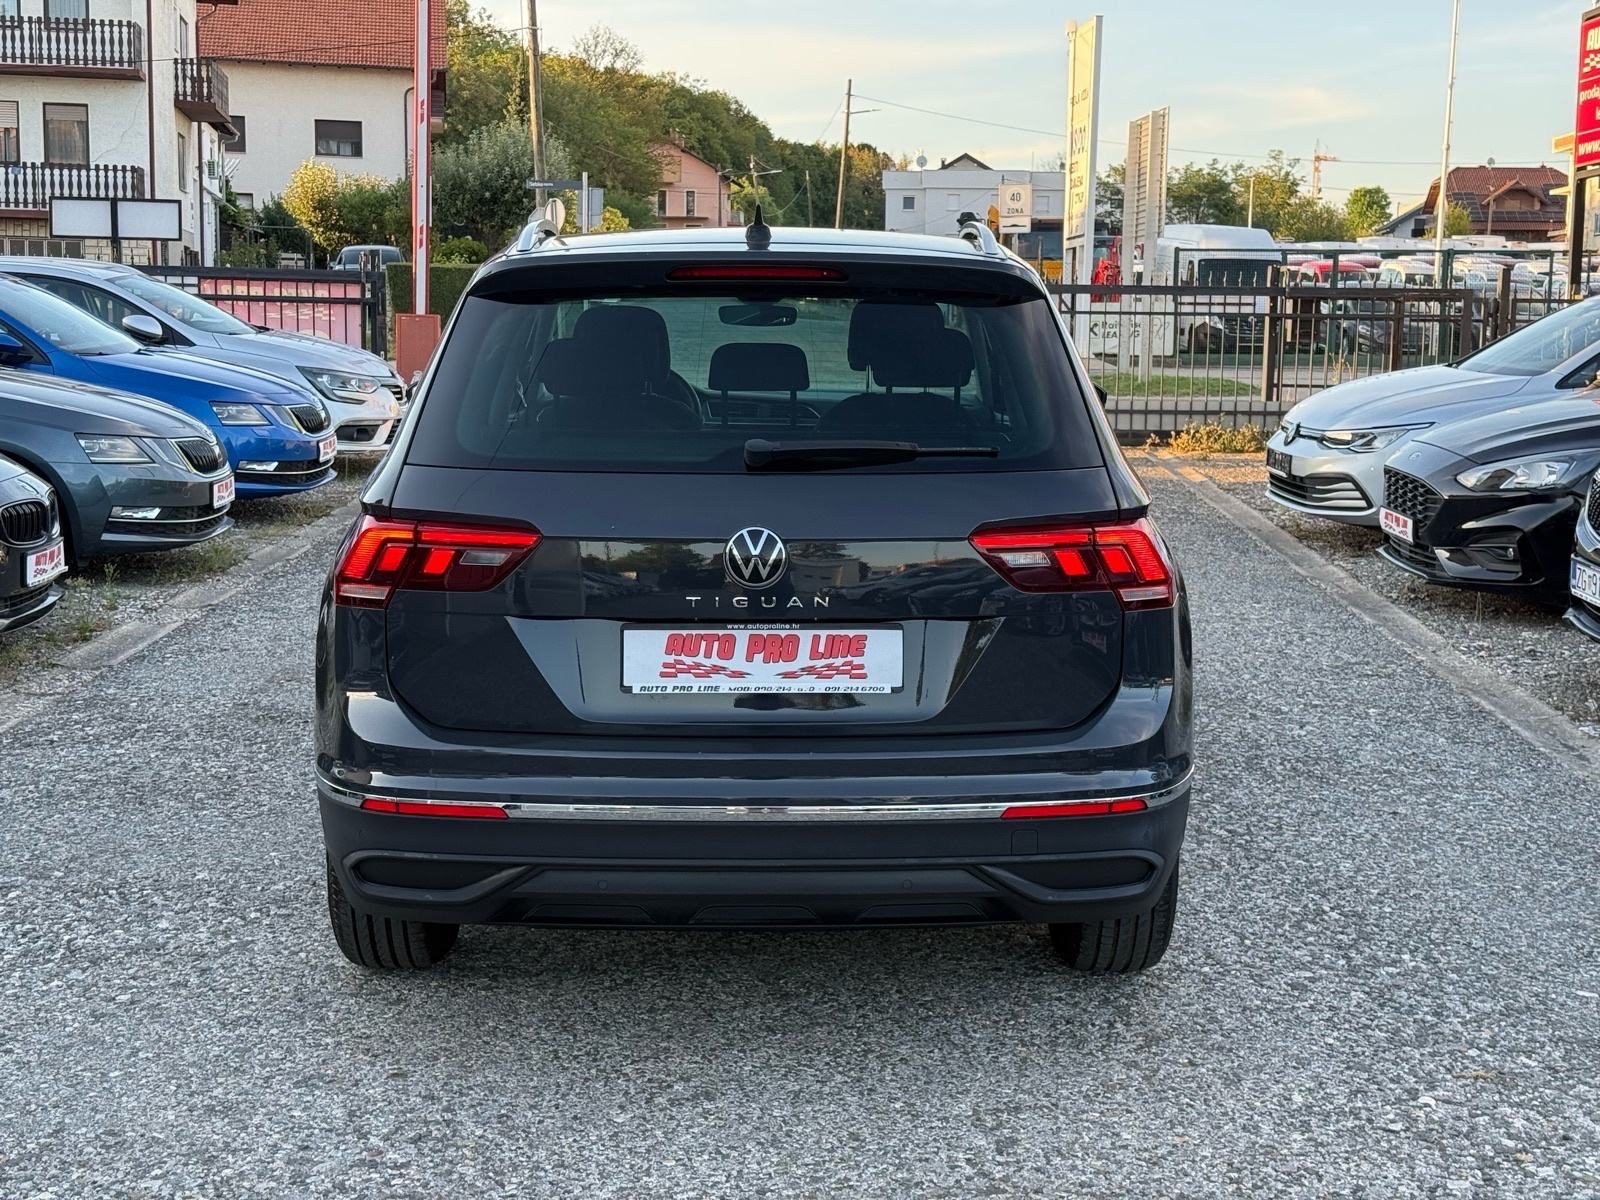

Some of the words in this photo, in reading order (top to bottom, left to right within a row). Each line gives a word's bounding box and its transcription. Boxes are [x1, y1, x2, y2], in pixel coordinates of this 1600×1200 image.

[1010, 192, 1021, 201] 40
[685, 596, 829, 608] TIGUAN
[726, 623, 800, 631] www.autoproline.hr
[664, 633, 736, 660] AUTO
[746, 633, 801, 664] PRO
[809, 634, 868, 660] LINE
[639, 685, 668, 693] AUTO
[672, 685, 694, 693] PRO
[697, 685, 721, 693] LINE
